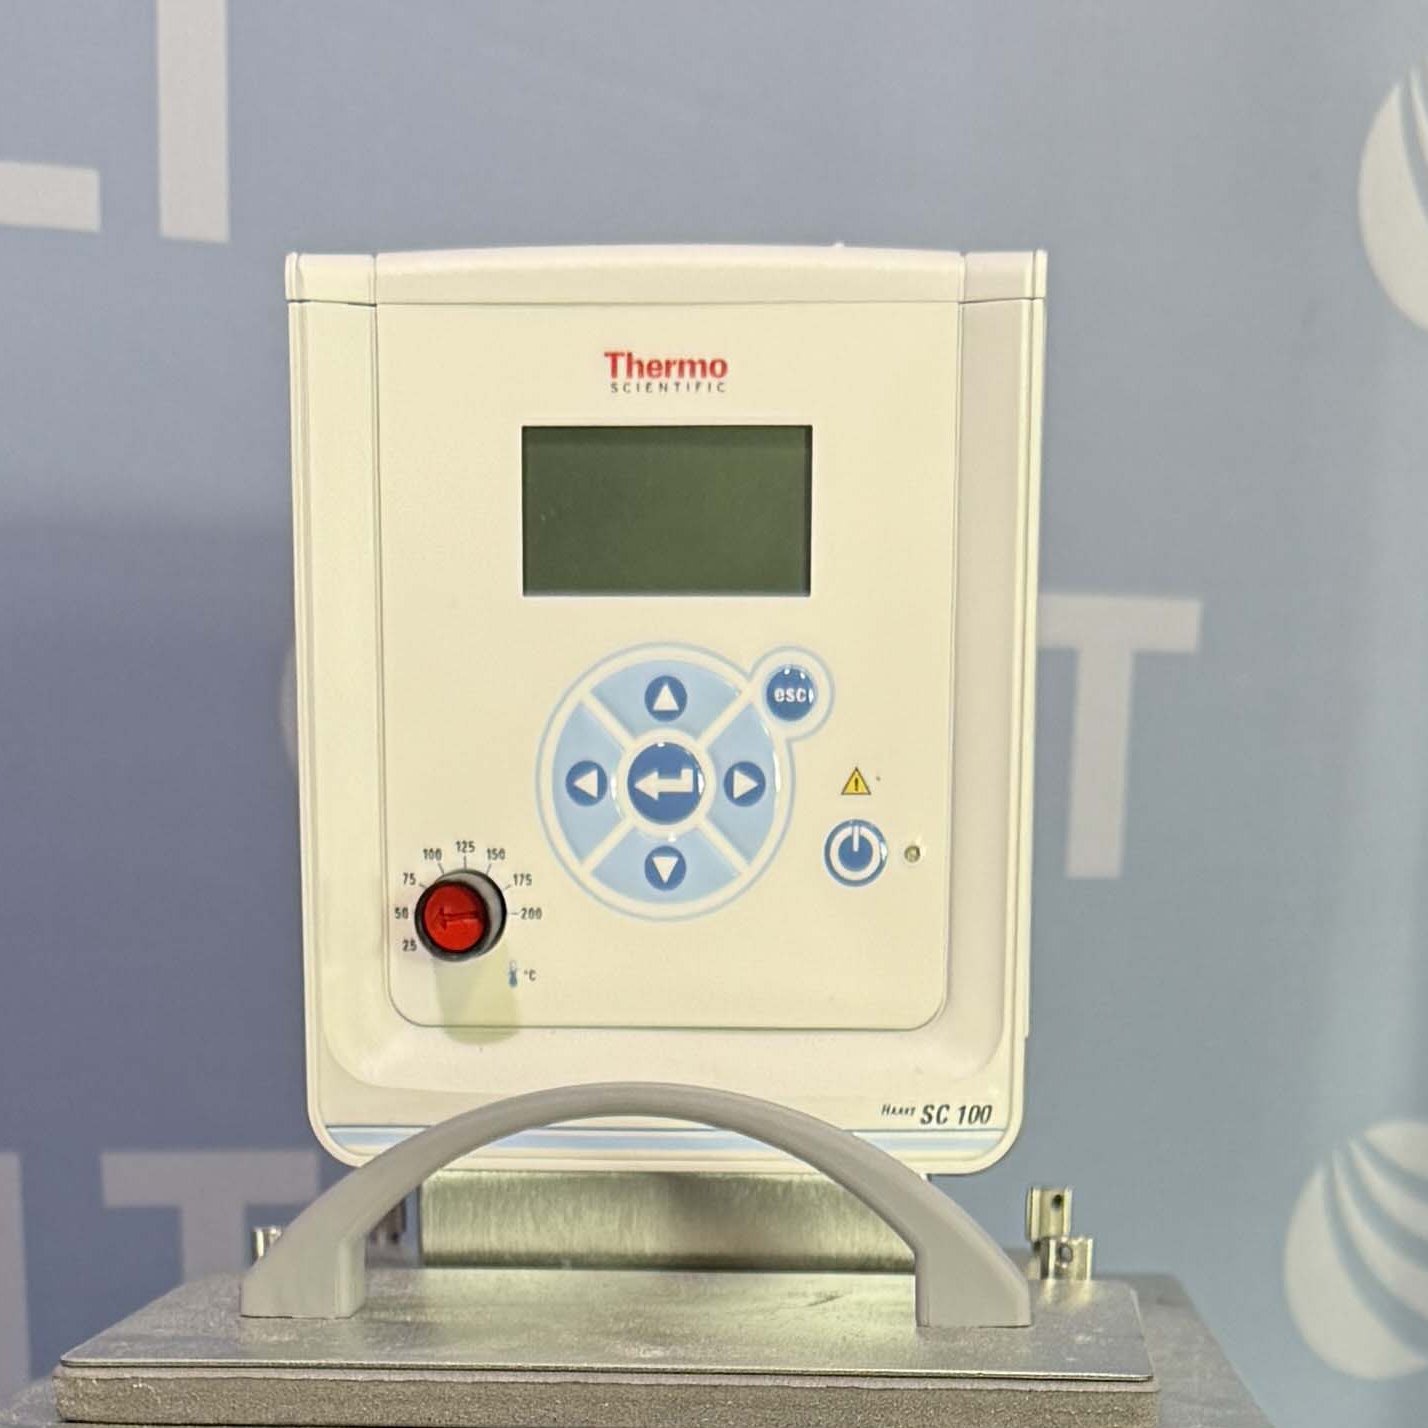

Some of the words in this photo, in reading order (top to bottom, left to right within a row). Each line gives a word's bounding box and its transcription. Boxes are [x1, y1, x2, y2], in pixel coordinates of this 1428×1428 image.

[604, 352, 728, 378] Thermo
[610, 382, 726, 393] SCIENTIFIC
[774, 687, 807, 702] esc
[456, 841, 475, 853] 125
[423, 848, 442, 861] 100
[487, 848, 506, 860] 150
[403, 873, 416, 885] 75
[513, 874, 532, 886] 175
[395, 908, 409, 919] 50
[521, 908, 542, 919] 200
[402, 940, 417, 951] 25
[920, 1104, 950, 1125] SC
[958, 1105, 992, 1125] 100
